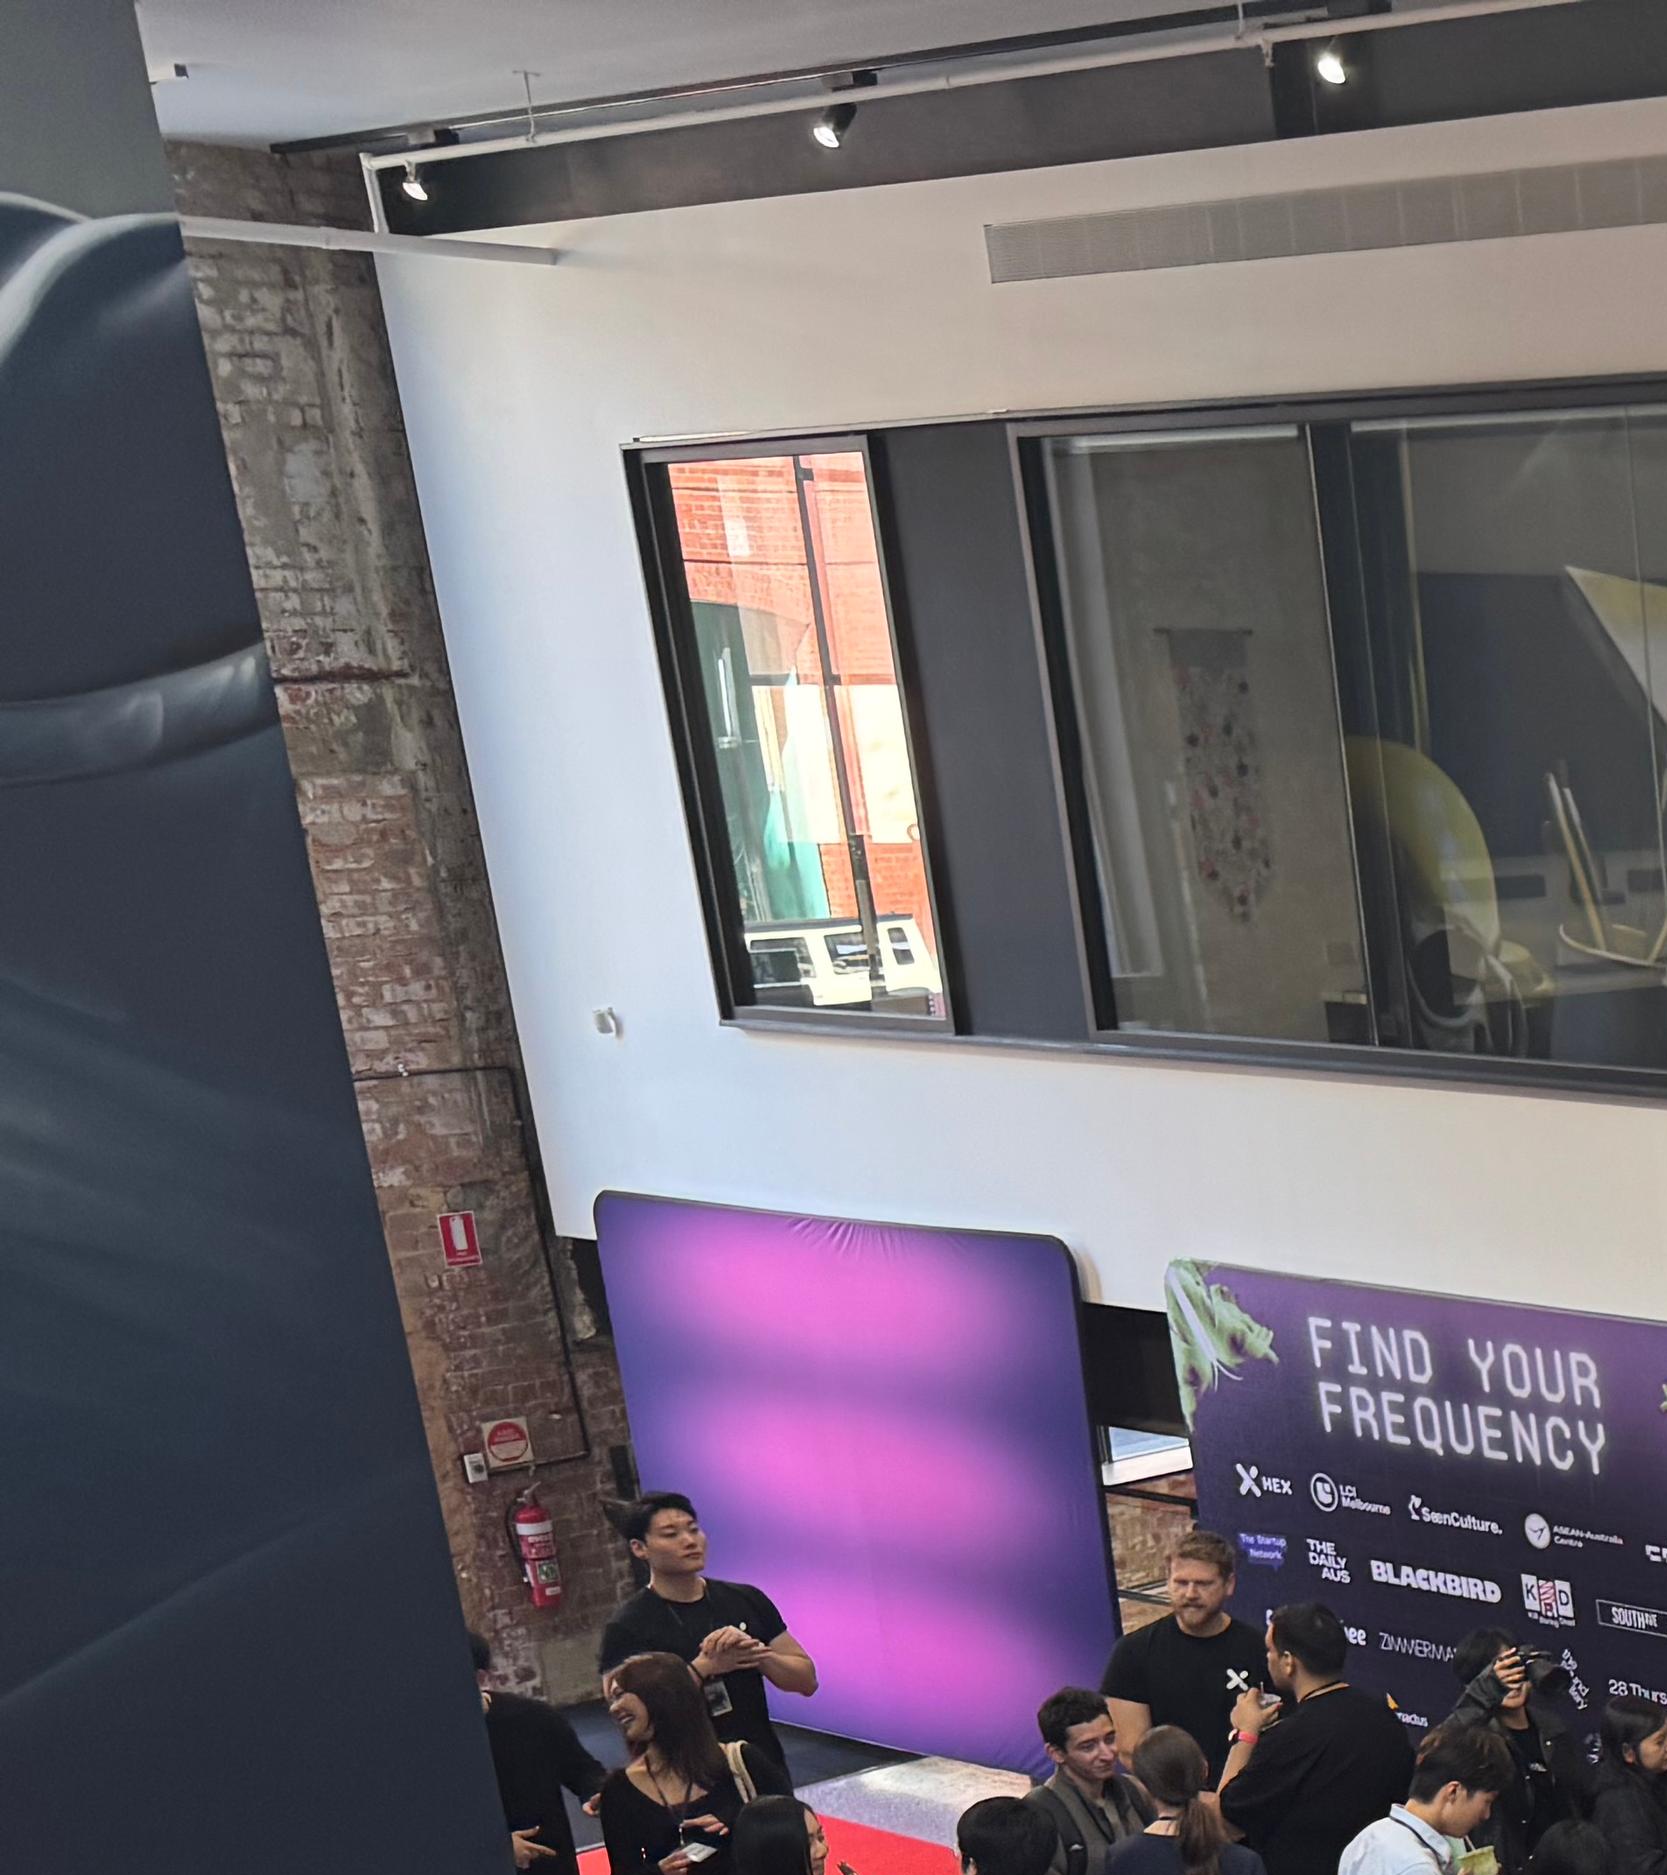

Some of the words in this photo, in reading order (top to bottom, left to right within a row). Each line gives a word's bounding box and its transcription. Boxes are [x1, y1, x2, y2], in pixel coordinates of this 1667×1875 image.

[1308, 1316, 1433, 1385] FIND
[1467, 1338, 1601, 1409] YOUR
[1318, 1381, 1606, 1475] FREQUENCY
[1261, 1476, 1293, 1495] HEX
[1341, 1498, 1391, 1515] Melbourne
[1421, 1507, 1503, 1535] SeenCulture.
[1306, 1538, 1337, 1556] THE
[1308, 1551, 1348, 1569] DAILY
[1321, 1567, 1351, 1584] AUS
[1370, 1559, 1502, 1603] BLACKBIRD
[1379, 1632, 1457, 1662] ZIMMERMA
[1608, 1679, 1629, 1696] 28
[1396, 1711, 1429, 1728] nactus
